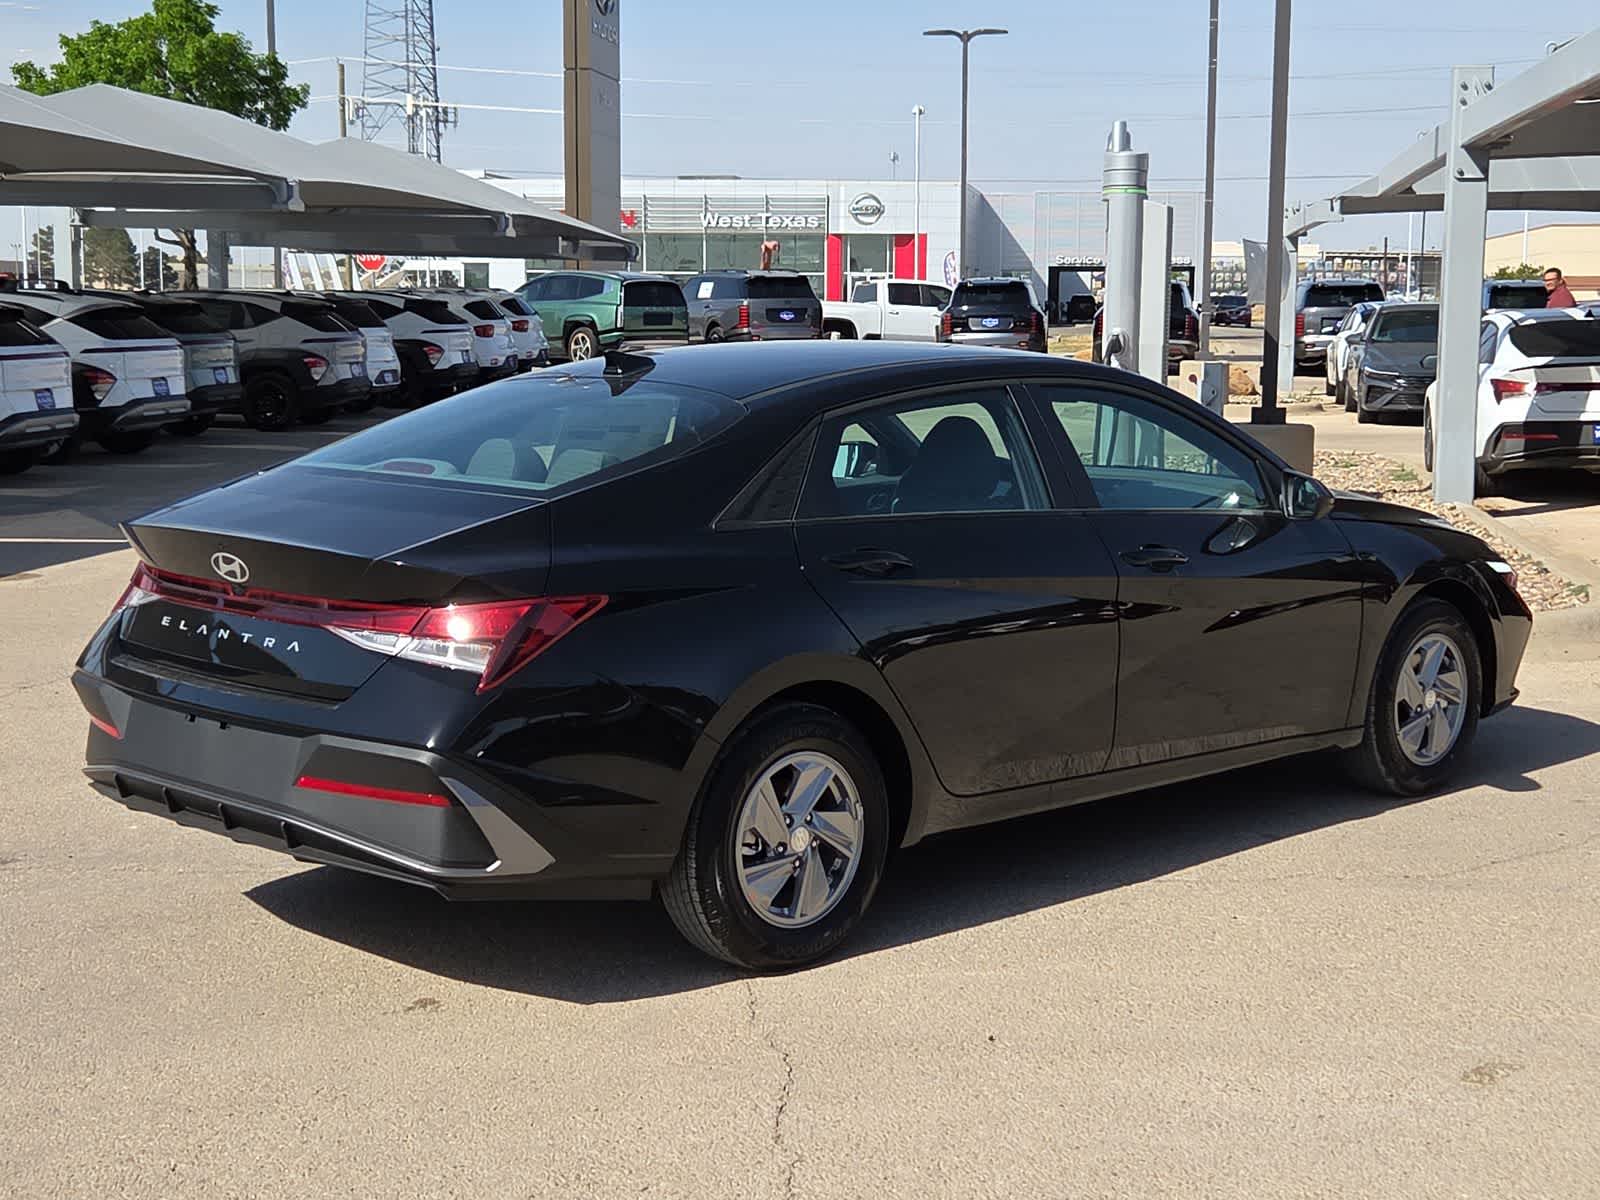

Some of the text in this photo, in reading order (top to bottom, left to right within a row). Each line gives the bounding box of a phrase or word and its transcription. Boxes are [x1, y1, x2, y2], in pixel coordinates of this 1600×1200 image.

[700, 212, 820, 228] West Texas
[1055, 254, 1101, 265] Service
[161, 615, 301, 652] ELANTRA
